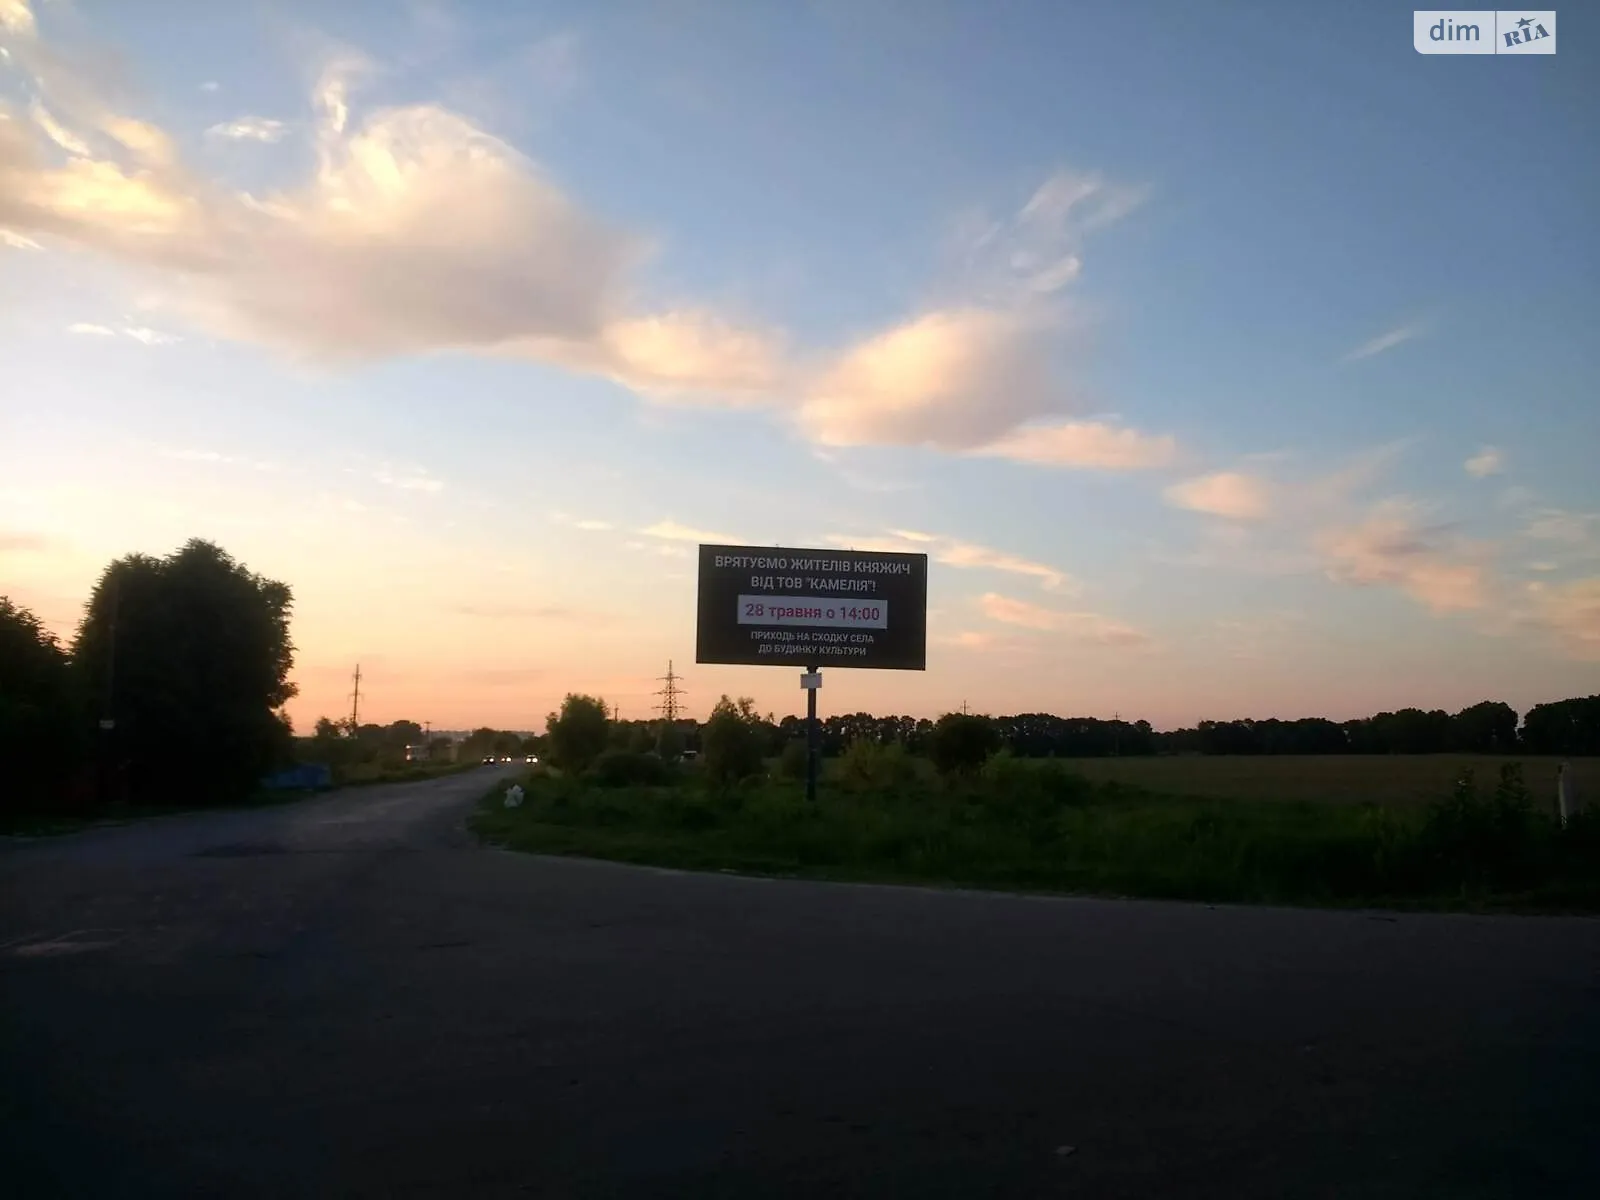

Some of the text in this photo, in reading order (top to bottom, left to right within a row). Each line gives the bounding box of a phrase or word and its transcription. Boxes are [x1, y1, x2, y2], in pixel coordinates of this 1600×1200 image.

[715, 556, 910, 574] ВРЯТУЄМО ЖИТЕЛІВ КНЯЖИЧ
[751, 576, 876, 592] ВІД ТОВ "КАМЕЛІЯ"!
[746, 604, 880, 620] 28 травня о 14:00
[751, 631, 874, 643] ПРИХОДЬ НА СХОДКУ СЕЛА
[758, 644, 866, 656] ДО БУДИНКУ КУЛЬТУРИ
